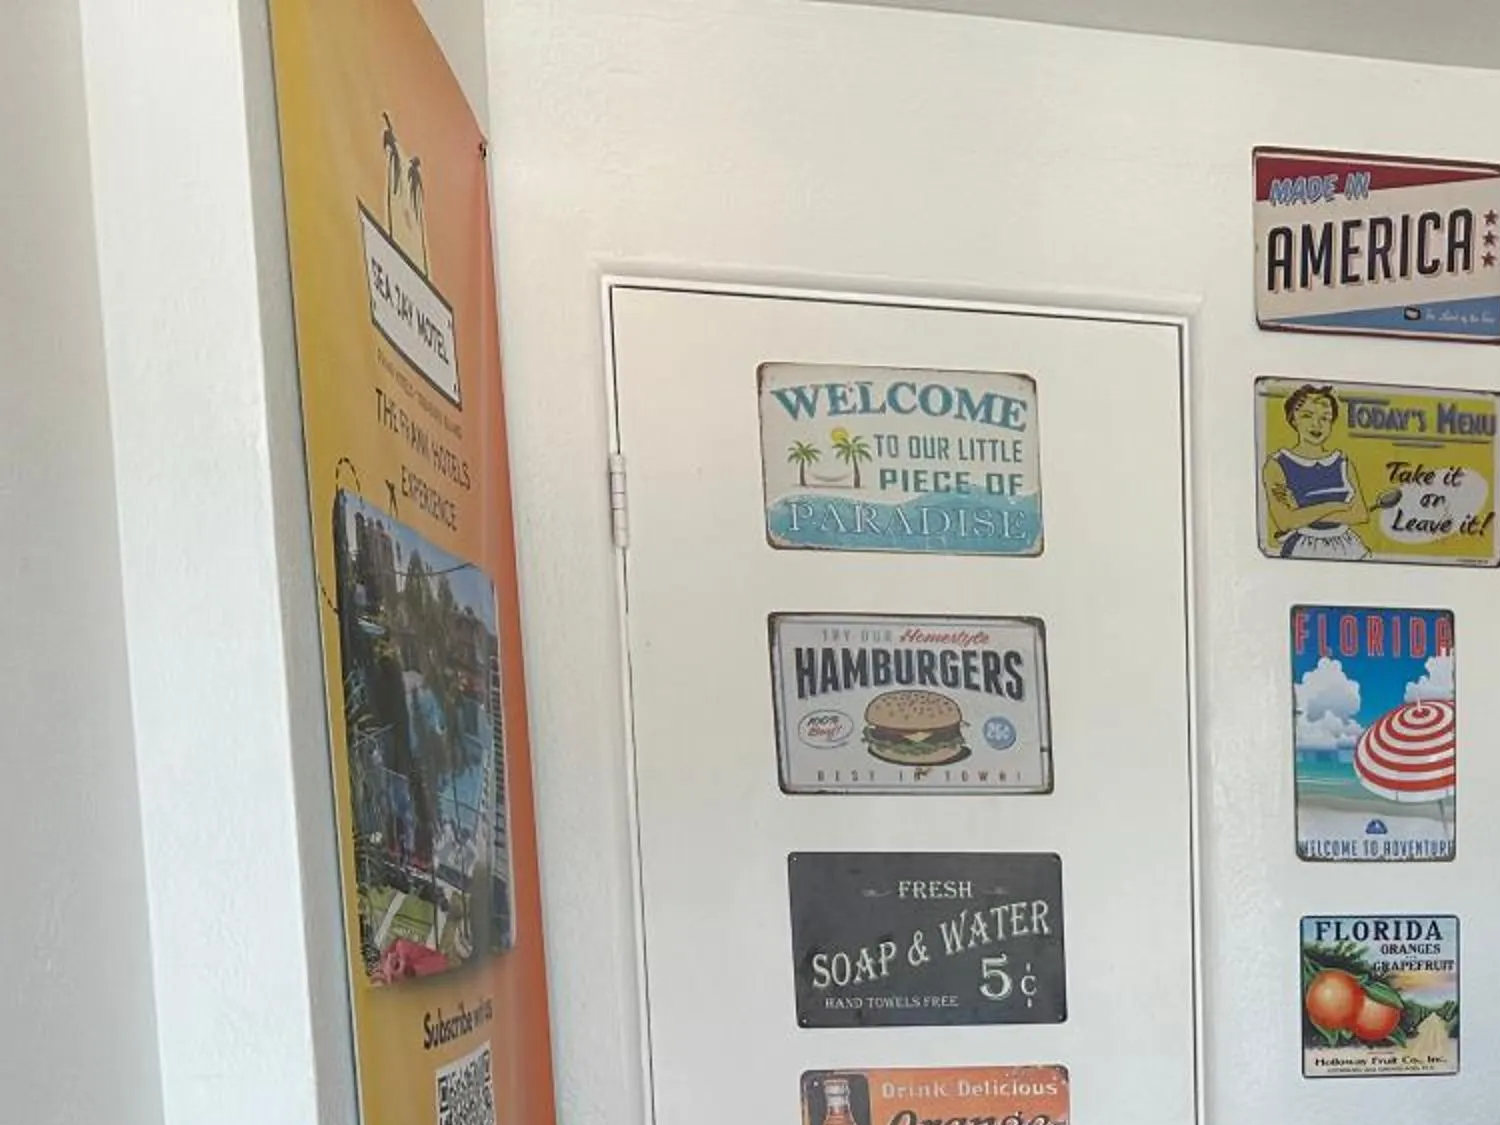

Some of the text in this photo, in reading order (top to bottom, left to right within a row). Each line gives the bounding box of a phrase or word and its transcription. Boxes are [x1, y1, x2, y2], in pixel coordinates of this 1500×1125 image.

[1270, 171, 1371, 206] MADE IN
[1267, 208, 1475, 293] AMERICA
[371, 257, 393, 302] SEA
[416, 311, 450, 365] MOTEL
[770, 381, 1028, 432] WELCOME
[873, 433, 1024, 464] TO OUR LITTLE
[431, 440, 472, 491] HOTELS
[1386, 461, 1465, 486] Take it
[879, 468, 1024, 497] PIECE OF
[400, 464, 458, 532] EXPERIENCE
[1419, 493, 1446, 509] or
[788, 500, 1027, 540] PARADISE
[1392, 510, 1495, 537] Leave it!
[899, 627, 990, 649] Homestyle
[1294, 612, 1454, 657] FLORIDA
[795, 646, 1025, 701] HAMBURGERS
[1362, 840, 1379, 857] TO
[898, 880, 973, 899] FRESH
[812, 899, 1052, 989] SOAP & WATER
[1315, 919, 1443, 942] FLORIDA
[1381, 943, 1442, 956] ORANGES
[1372, 959, 1455, 972] GRAPEFRUIT
[825, 994, 959, 1009] HAND TOWELS FREE
[882, 1076, 1058, 1099] Drink Delicious
